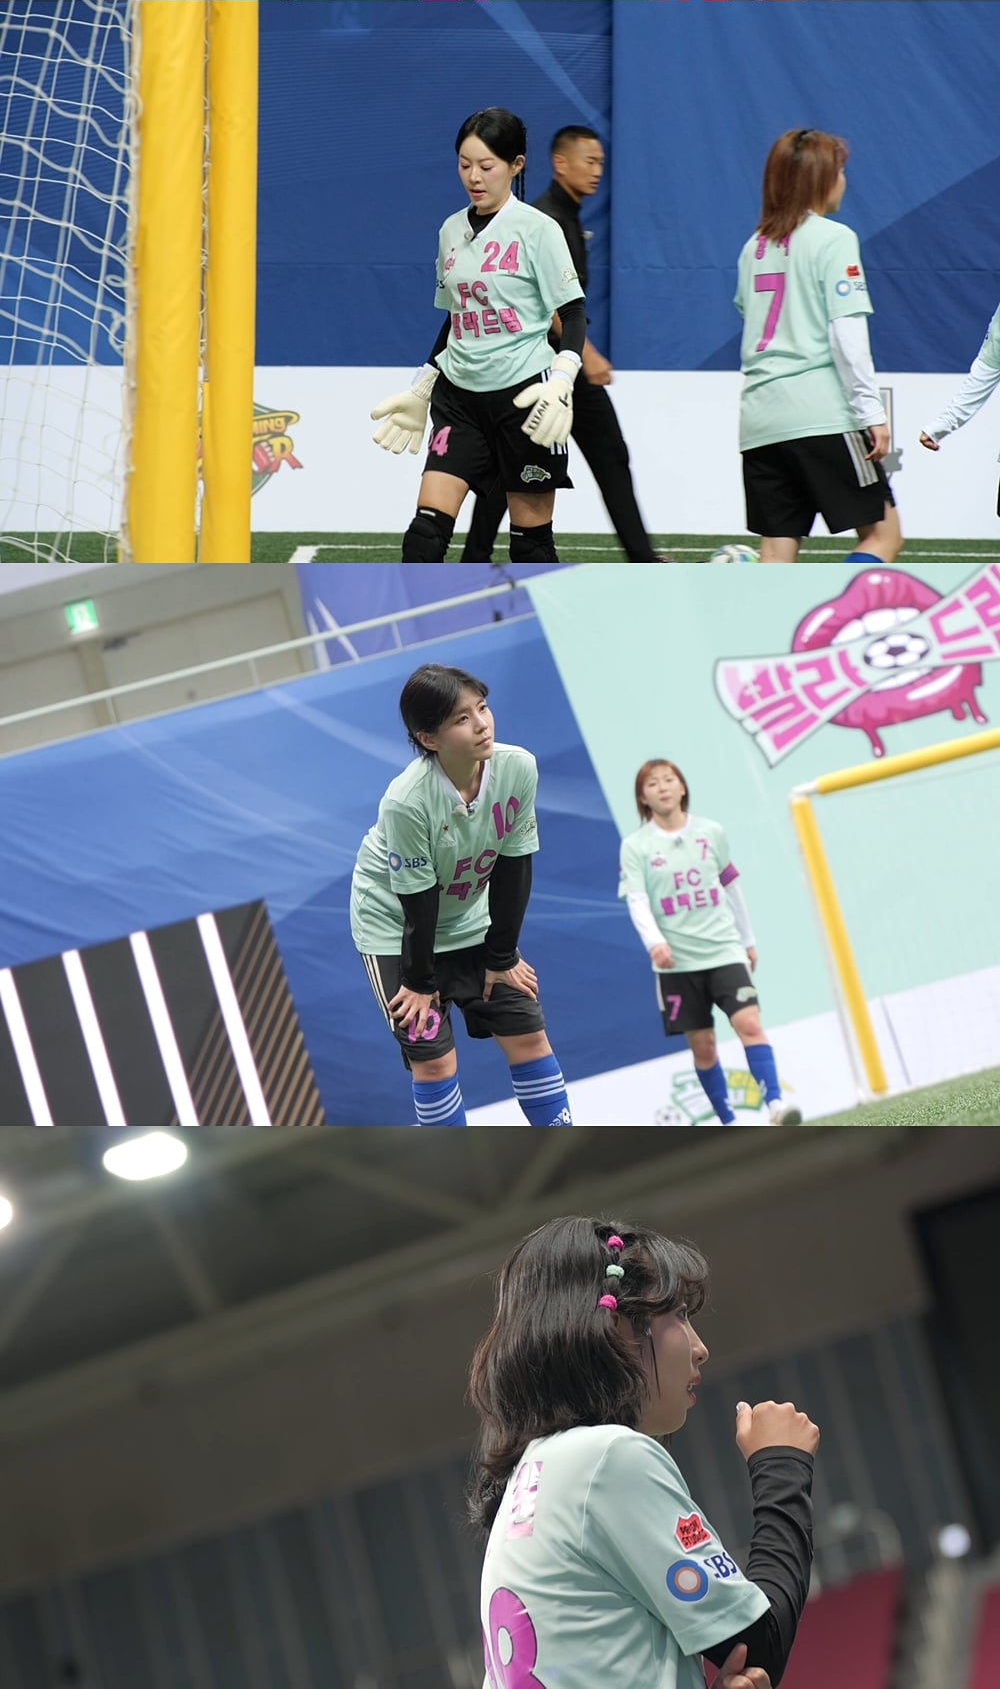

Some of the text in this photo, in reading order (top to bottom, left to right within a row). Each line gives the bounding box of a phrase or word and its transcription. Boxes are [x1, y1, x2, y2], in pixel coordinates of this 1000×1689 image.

[481, 241, 519, 275] 24
[457, 280, 488, 309] FC
[754, 272, 785, 352] 7
[428, 425, 452, 456] 4
[492, 795, 520, 840] 10
[404, 856, 428, 868] SBS
[695, 838, 708, 861] 7
[453, 849, 497, 881] FC
[673, 868, 702, 890] FC
[666, 994, 682, 1022] 7
